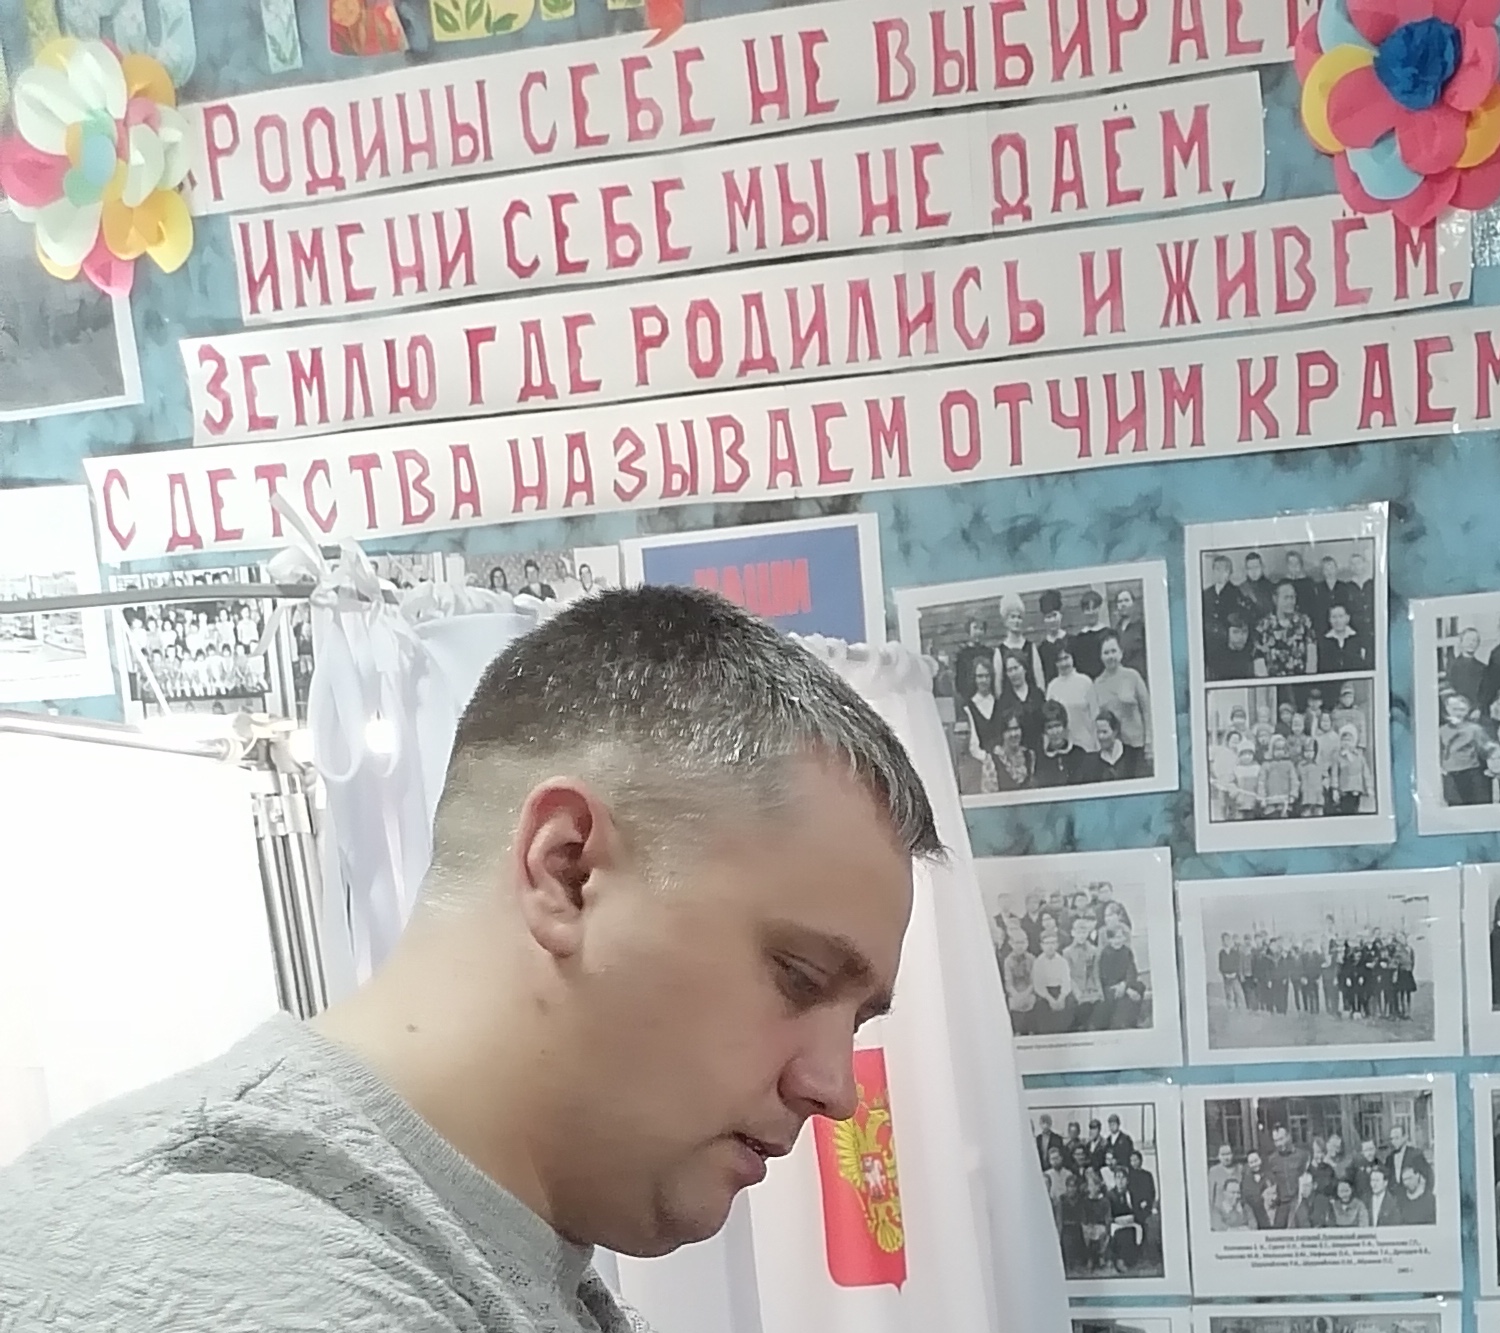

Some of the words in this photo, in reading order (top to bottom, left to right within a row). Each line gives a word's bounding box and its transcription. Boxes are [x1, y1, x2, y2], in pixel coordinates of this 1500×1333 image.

[519, 47, 714, 156] СЕБЕ
[745, 28, 840, 125] НЕ
[239, 204, 476, 316] ИМЕНИ
[503, 178, 692, 280] СЕБЕ
[724, 158, 829, 255] МЫ
[857, 141, 952, 237] НЕ
[198, 333, 438, 436] ЗЕМЛЮ
[465, 312, 602, 406] ГДЕ
[630, 261, 1045, 387] РОДИЛИСЬ
[1080, 247, 1127, 336] И
[103, 468, 137, 550] С
[166, 443, 482, 553] ДЕТСТВА
[510, 396, 913, 514] НАЗЫВАЕМ
[939, 362, 1207, 473] ОТЧИМ
